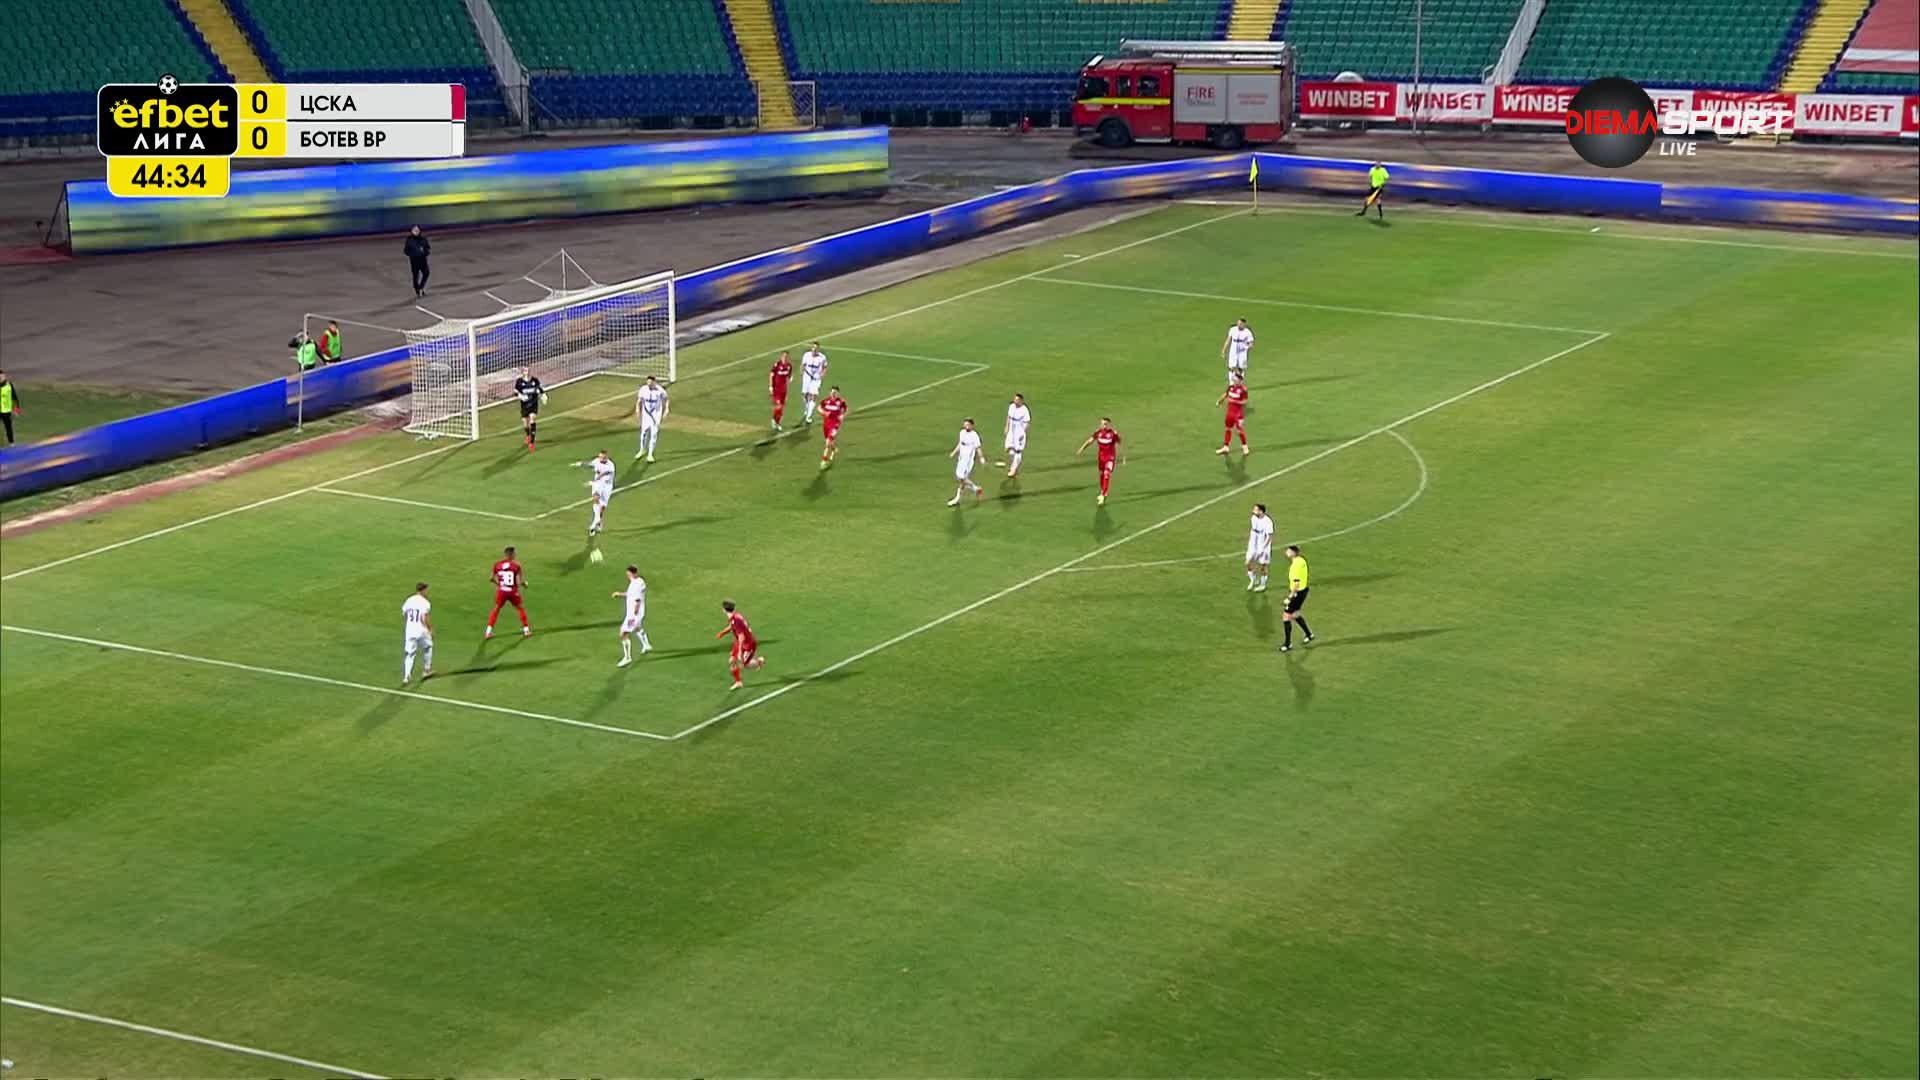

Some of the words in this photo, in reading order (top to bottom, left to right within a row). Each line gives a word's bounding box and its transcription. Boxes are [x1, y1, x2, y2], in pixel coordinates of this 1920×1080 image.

[1187, 86, 1215, 99] FIRE
[1309, 89, 1390, 109] WINBET
[1405, 92, 1486, 112] WINBET
[1502, 94, 1575, 113] WINBE
[1804, 103, 1894, 122] WINBET
